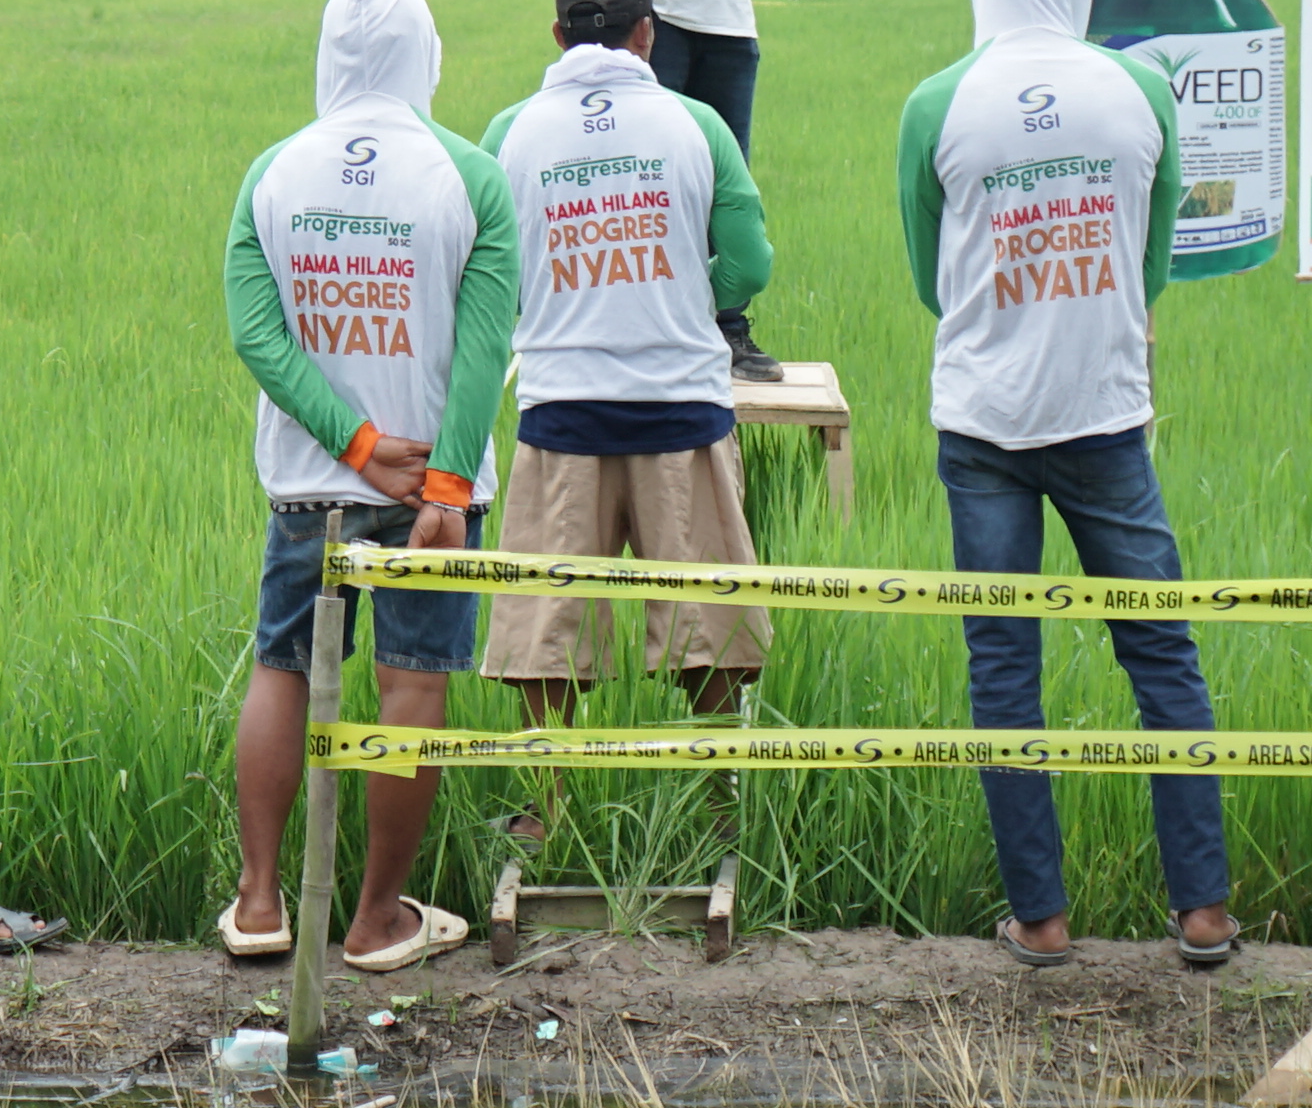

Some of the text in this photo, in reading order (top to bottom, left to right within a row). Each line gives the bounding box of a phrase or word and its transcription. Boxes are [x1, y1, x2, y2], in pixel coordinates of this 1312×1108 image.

[583, 116, 616, 134] SGI
[1023, 113, 1061, 133] SGI
[1213, 105, 1245, 119] 400
[341, 169, 376, 187] SGI
[540, 158, 664, 188] Progressive
[638, 172, 664, 181] 50 SC
[982, 158, 1113, 194] Progressive
[1086, 174, 1113, 185] 50 SC
[545, 190, 670, 223] HAMA HILANG
[990, 194, 1115, 233] HAMA HILANG
[291, 214, 413, 241] Progressive
[388, 237, 412, 248] 50 SC
[548, 212, 669, 254] PROGRES
[993, 219, 1113, 265] PROGRES
[290, 253, 416, 278] HAMA HILANG
[550, 244, 675, 294] NYATA
[292, 278, 412, 312] PROGRES
[994, 254, 1117, 310] NYATA
[296, 312, 416, 358] NYATA
[328, 555, 355, 575] SGI
[442, 559, 490, 582] AREA
[493, 561, 520, 583] SGI
[771, 577, 819, 597] AREA
[822, 578, 850, 599] SGI
[937, 582, 983, 604] AREA
[987, 584, 1016, 606] SGI
[1104, 589, 1150, 610] AREA
[1154, 590, 1183, 610] SGI
[309, 735, 332, 757] SGI
[418, 739, 465, 760] AREA
[468, 739, 496, 758] SGI
[748, 740, 795, 760] AREA
[798, 740, 826, 761] SGI
[914, 741, 959, 762] AREA
[964, 742, 993, 764] SGI
[1080, 743, 1126, 765] AREA
[1131, 744, 1160, 766] SGI
[1248, 744, 1294, 766] AREA
